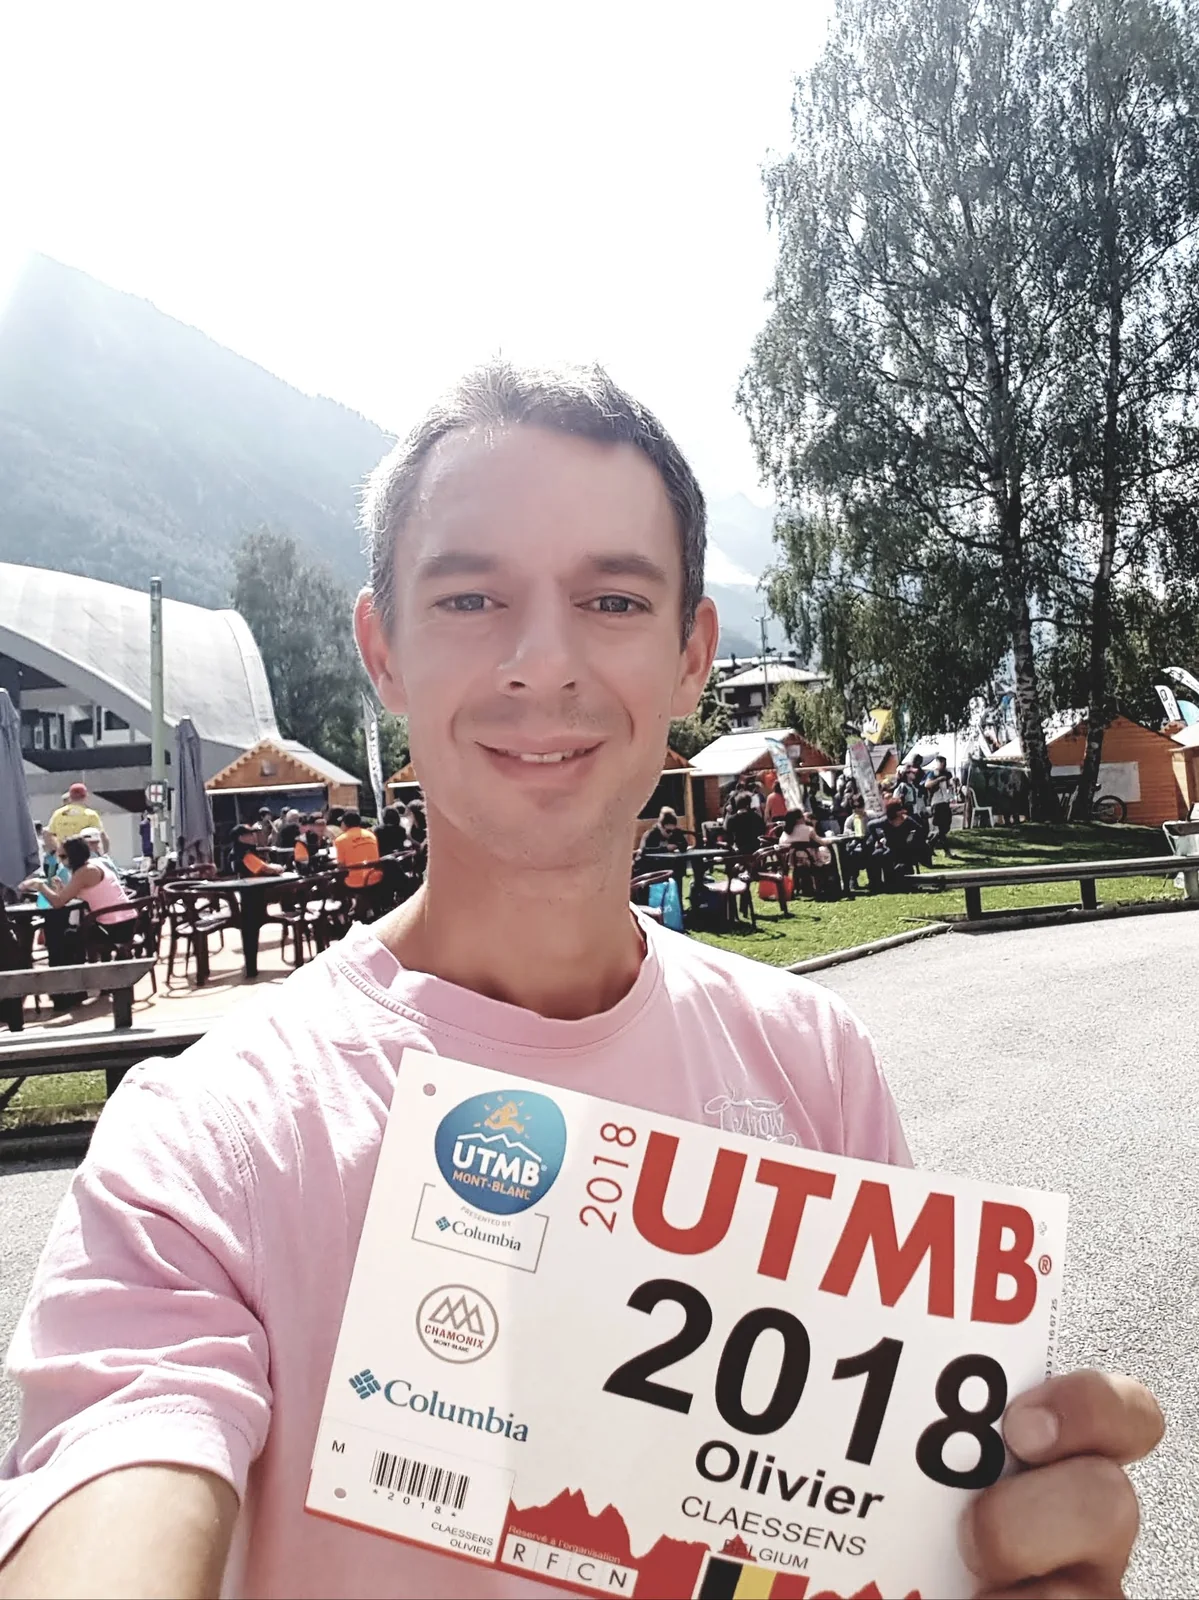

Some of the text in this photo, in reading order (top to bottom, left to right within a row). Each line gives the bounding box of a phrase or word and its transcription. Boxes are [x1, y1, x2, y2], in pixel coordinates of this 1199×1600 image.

[452, 1170, 531, 1200] MONT-BLANC
[579, 1122, 637, 1234] 2018
[452, 1220, 521, 1251] Columbia
[424, 1324, 485, 1349] CHAMONIX
[602, 1278, 1008, 1489] 2018
[383, 1378, 530, 1442] Columbia
[332, 1439, 346, 1454] M
[695, 1439, 884, 1520] Olivier
[431, 1521, 494, 1546] CLAESSENS
[680, 1495, 867, 1558] CLAESSENS
[449, 1538, 491, 1557] OLIVIER
[513, 1542, 627, 1588] R F C N
